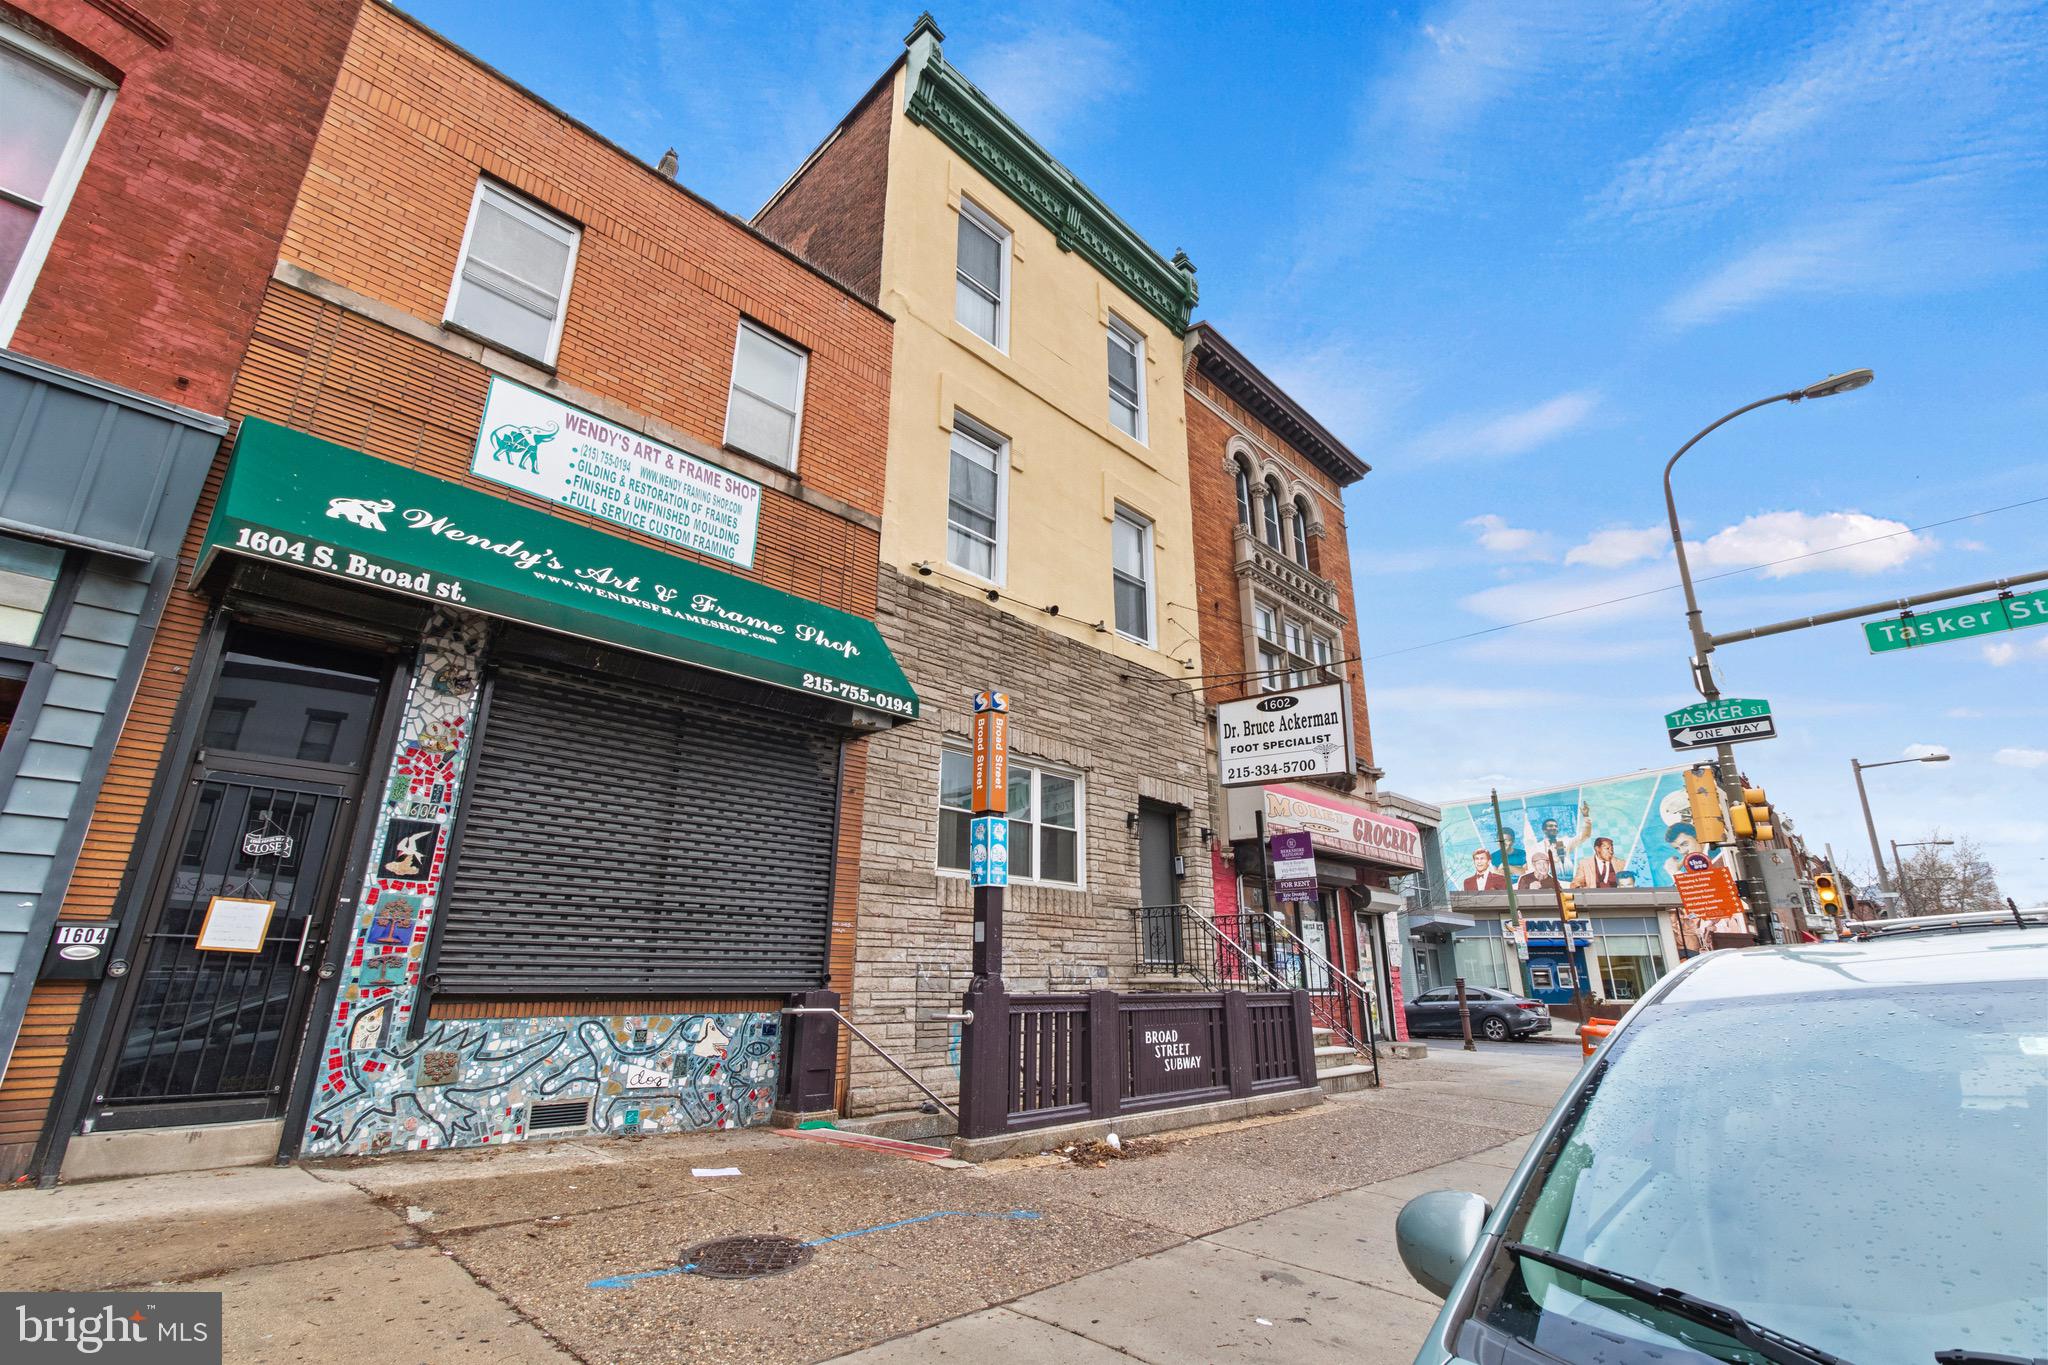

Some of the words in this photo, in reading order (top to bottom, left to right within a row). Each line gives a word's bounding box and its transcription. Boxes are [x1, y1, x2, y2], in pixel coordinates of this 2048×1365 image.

[565, 413, 630, 452] WENDY'S
[633, 442, 662, 464] ART
[665, 454, 674, 470] &
[679, 459, 722, 488] FRAME
[725, 478, 757, 502] SHOP
[578, 460, 616, 484] GILDING
[619, 475, 626, 487] &
[629, 478, 690, 511] RESTORATION
[692, 502, 702, 514] OF
[706, 508, 738, 529] FRAMES
[580, 444, 599, 462] (215)
[601, 451, 631, 472] 755-0194
[640, 466, 683, 492] WWW.WENDY
[683, 484, 711, 504] FRAMING
[712, 494, 742, 515] SHOP.COM
[570, 491, 596, 512] FULL
[600, 502, 646, 528] SERVICE
[649, 519, 690, 544] CUSTOM
[692, 534, 735, 559] FRAMING
[574, 475, 621, 502] FINISHED
[624, 493, 630, 506] &
[634, 496, 690, 526] UNFINISHED
[693, 519, 740, 544] MOULDING
[236, 528, 306, 562] 1604
[312, 546, 338, 570] S.
[344, 554, 430, 594] Broad
[435, 581, 467, 602] st.
[402, 509, 564, 569] Wendy's
[574, 567, 640, 592] Art
[654, 584, 678, 602] &
[690, 594, 786, 635] Frame
[794, 624, 860, 658] Shop
[1879, 610, 1992, 642] Tasker
[2008, 598, 2048, 620] St
[802, 673, 913, 715] 215-755-0194
[1264, 698, 1290, 710] 1602
[1224, 724, 1240, 740] Dr.
[1243, 720, 1274, 736] Bruce
[1278, 711, 1338, 732] Ackerman
[1672, 706, 1743, 726] TASKER
[1750, 706, 1763, 715] ST
[1696, 728, 1723, 740] ONE
[1731, 723, 1760, 734] WAY
[977, 718, 985, 751] Broad
[996, 718, 1004, 751] Broad
[1230, 744, 1259, 754] FOOT
[1263, 734, 1331, 750] SPECIALIST
[976, 754, 984, 790] Street
[994, 754, 1003, 790] Street
[1228, 759, 1316, 780] 215-334-5700
[1352, 818, 1416, 855] GROCERY
[64, 928, 106, 943] 1604
[1145, 1030, 1178, 1044] BROAD
[1154, 1043, 1190, 1058] STREET
[1164, 1056, 1201, 1072] SUBWAY
